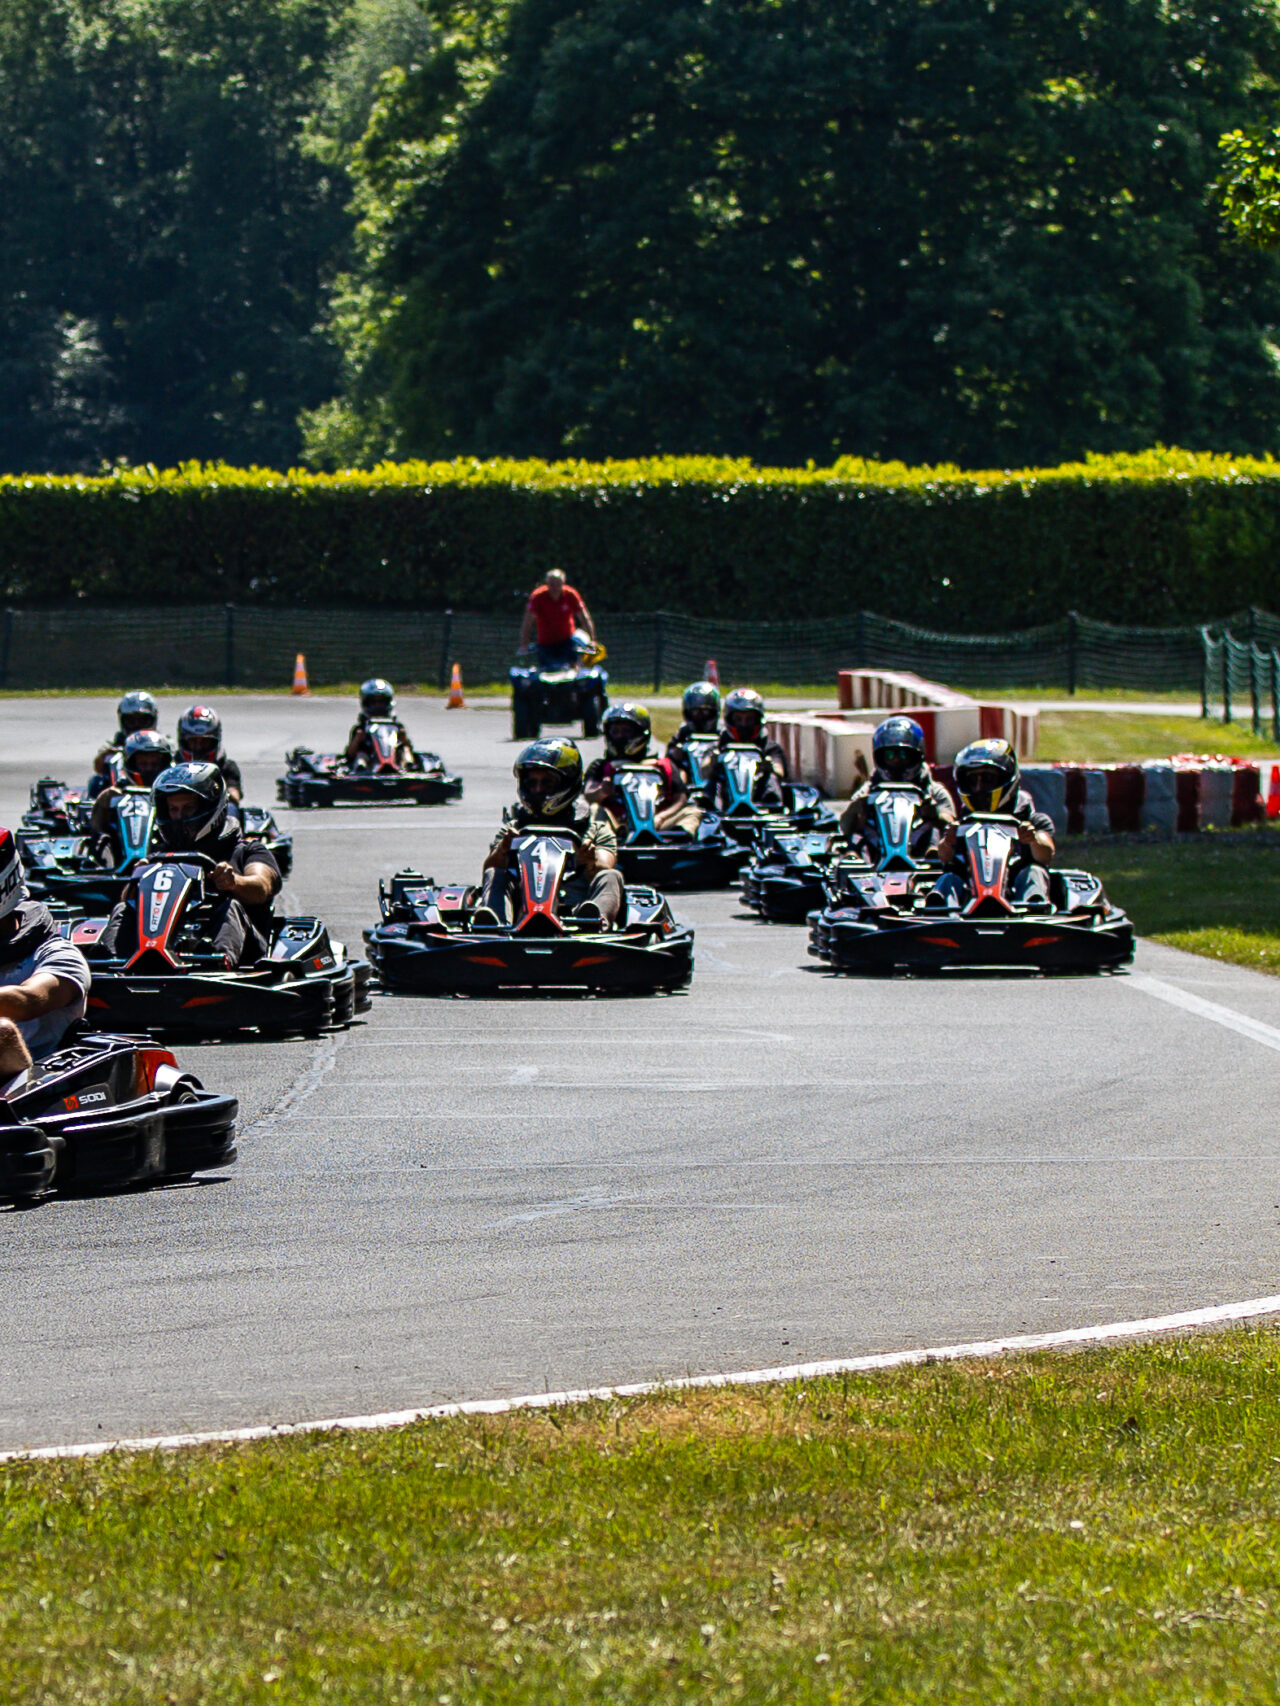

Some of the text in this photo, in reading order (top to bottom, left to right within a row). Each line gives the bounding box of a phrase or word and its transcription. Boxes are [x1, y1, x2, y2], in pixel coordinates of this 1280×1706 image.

[121, 800, 149, 817] 23
[531, 841, 548, 863] 4
[153, 869, 174, 891] 6
[78, 1091, 107, 1105] SODI
